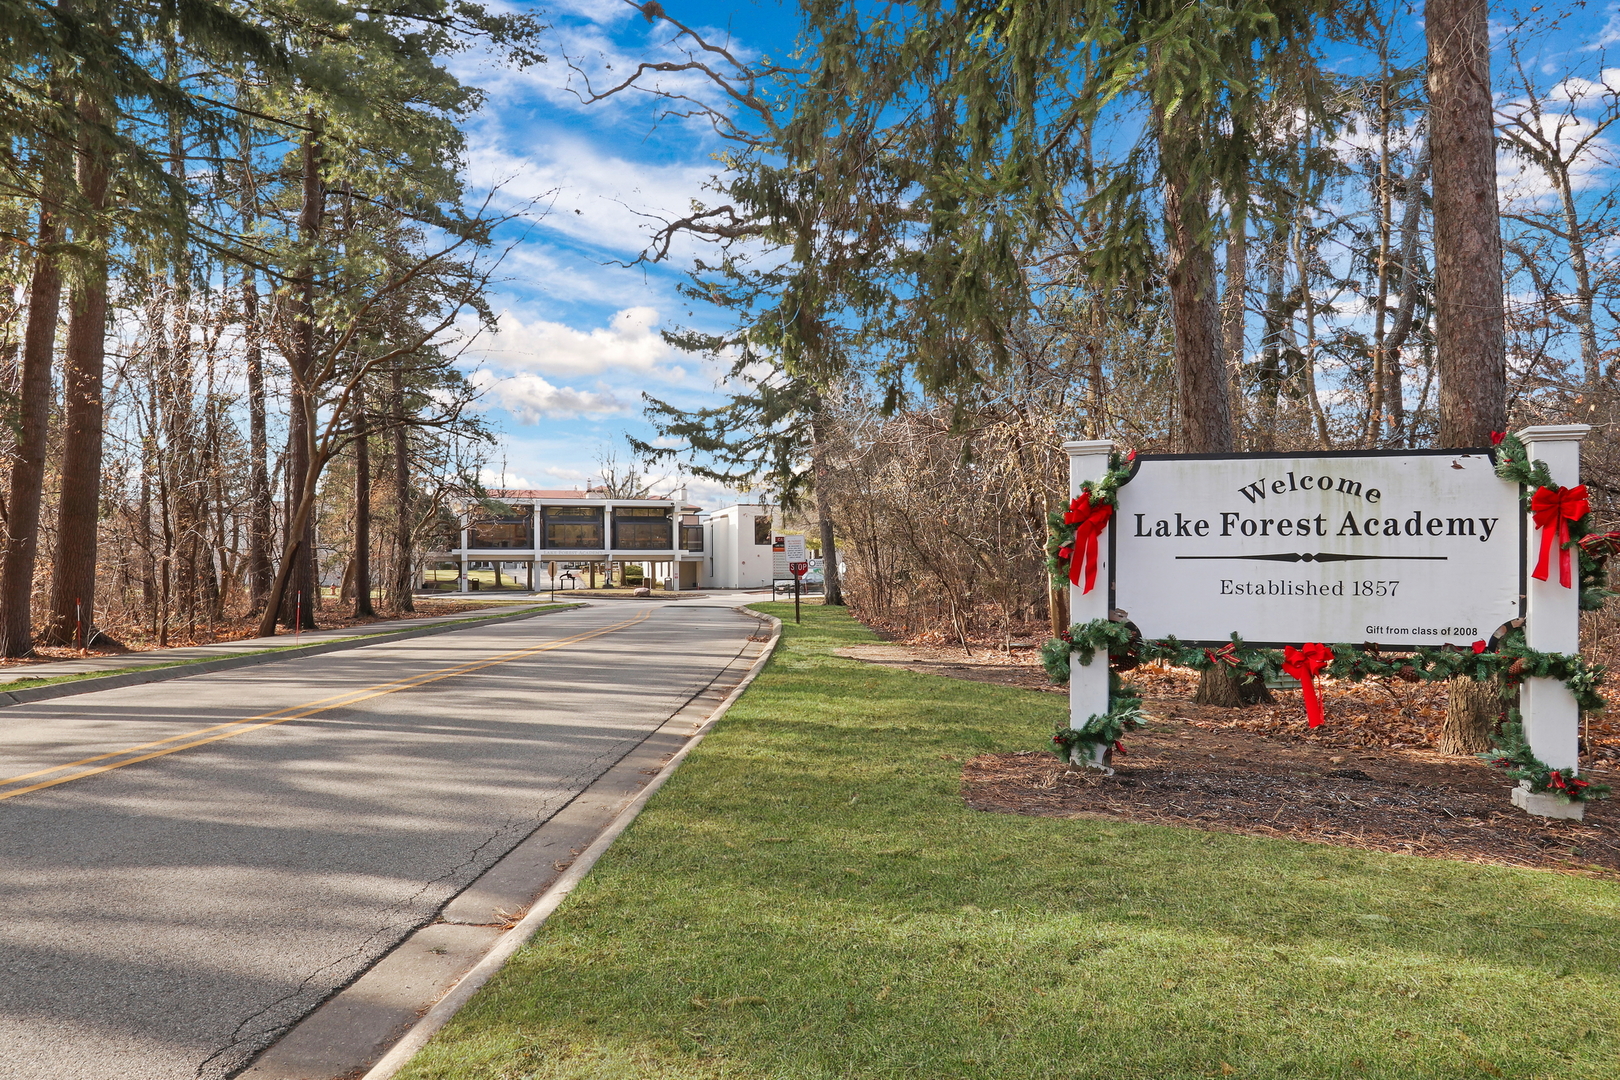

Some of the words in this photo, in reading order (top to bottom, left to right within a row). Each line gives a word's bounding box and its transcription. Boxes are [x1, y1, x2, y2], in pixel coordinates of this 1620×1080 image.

[1238, 471, 1381, 504] Welcome
[1133, 512, 1210, 538] Lake
[1219, 512, 1327, 537] Forest
[1335, 510, 1499, 543] Academy
[1220, 579, 1344, 596] Established
[1353, 580, 1400, 597] 1857
[1366, 625, 1384, 634] Gift
[1385, 625, 1409, 635] from
[1411, 626, 1438, 636] class
[1440, 626, 1451, 636] of
[1453, 627, 1478, 636] 2008
